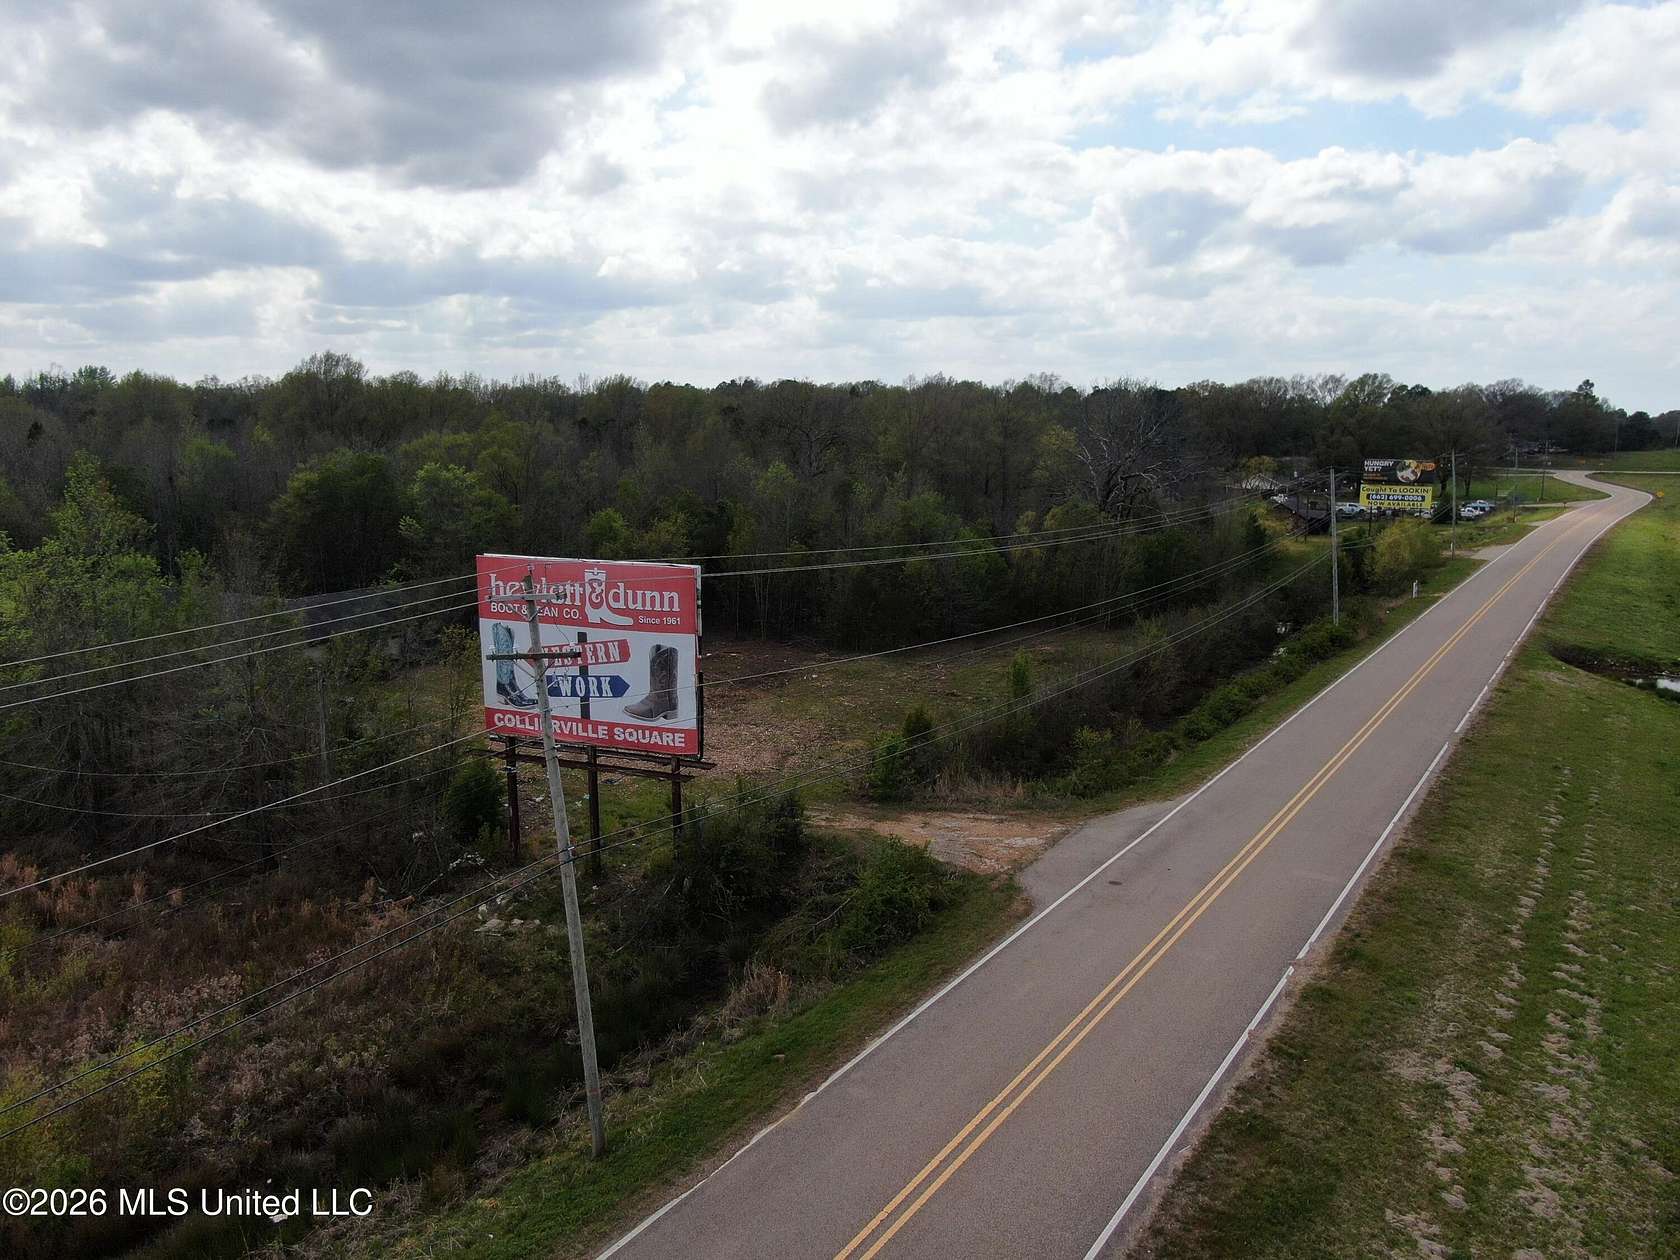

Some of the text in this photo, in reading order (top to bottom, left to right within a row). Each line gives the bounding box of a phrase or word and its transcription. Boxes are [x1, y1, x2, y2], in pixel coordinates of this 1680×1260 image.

[591, 582, 603, 603] &
[608, 582, 680, 612] dunn
[563, 608, 582, 619] CO.
[638, 615, 681, 625] Since 1961
[557, 676, 613, 697] WORK
[493, 713, 685, 747] COLLIRVILLE SQUARE
